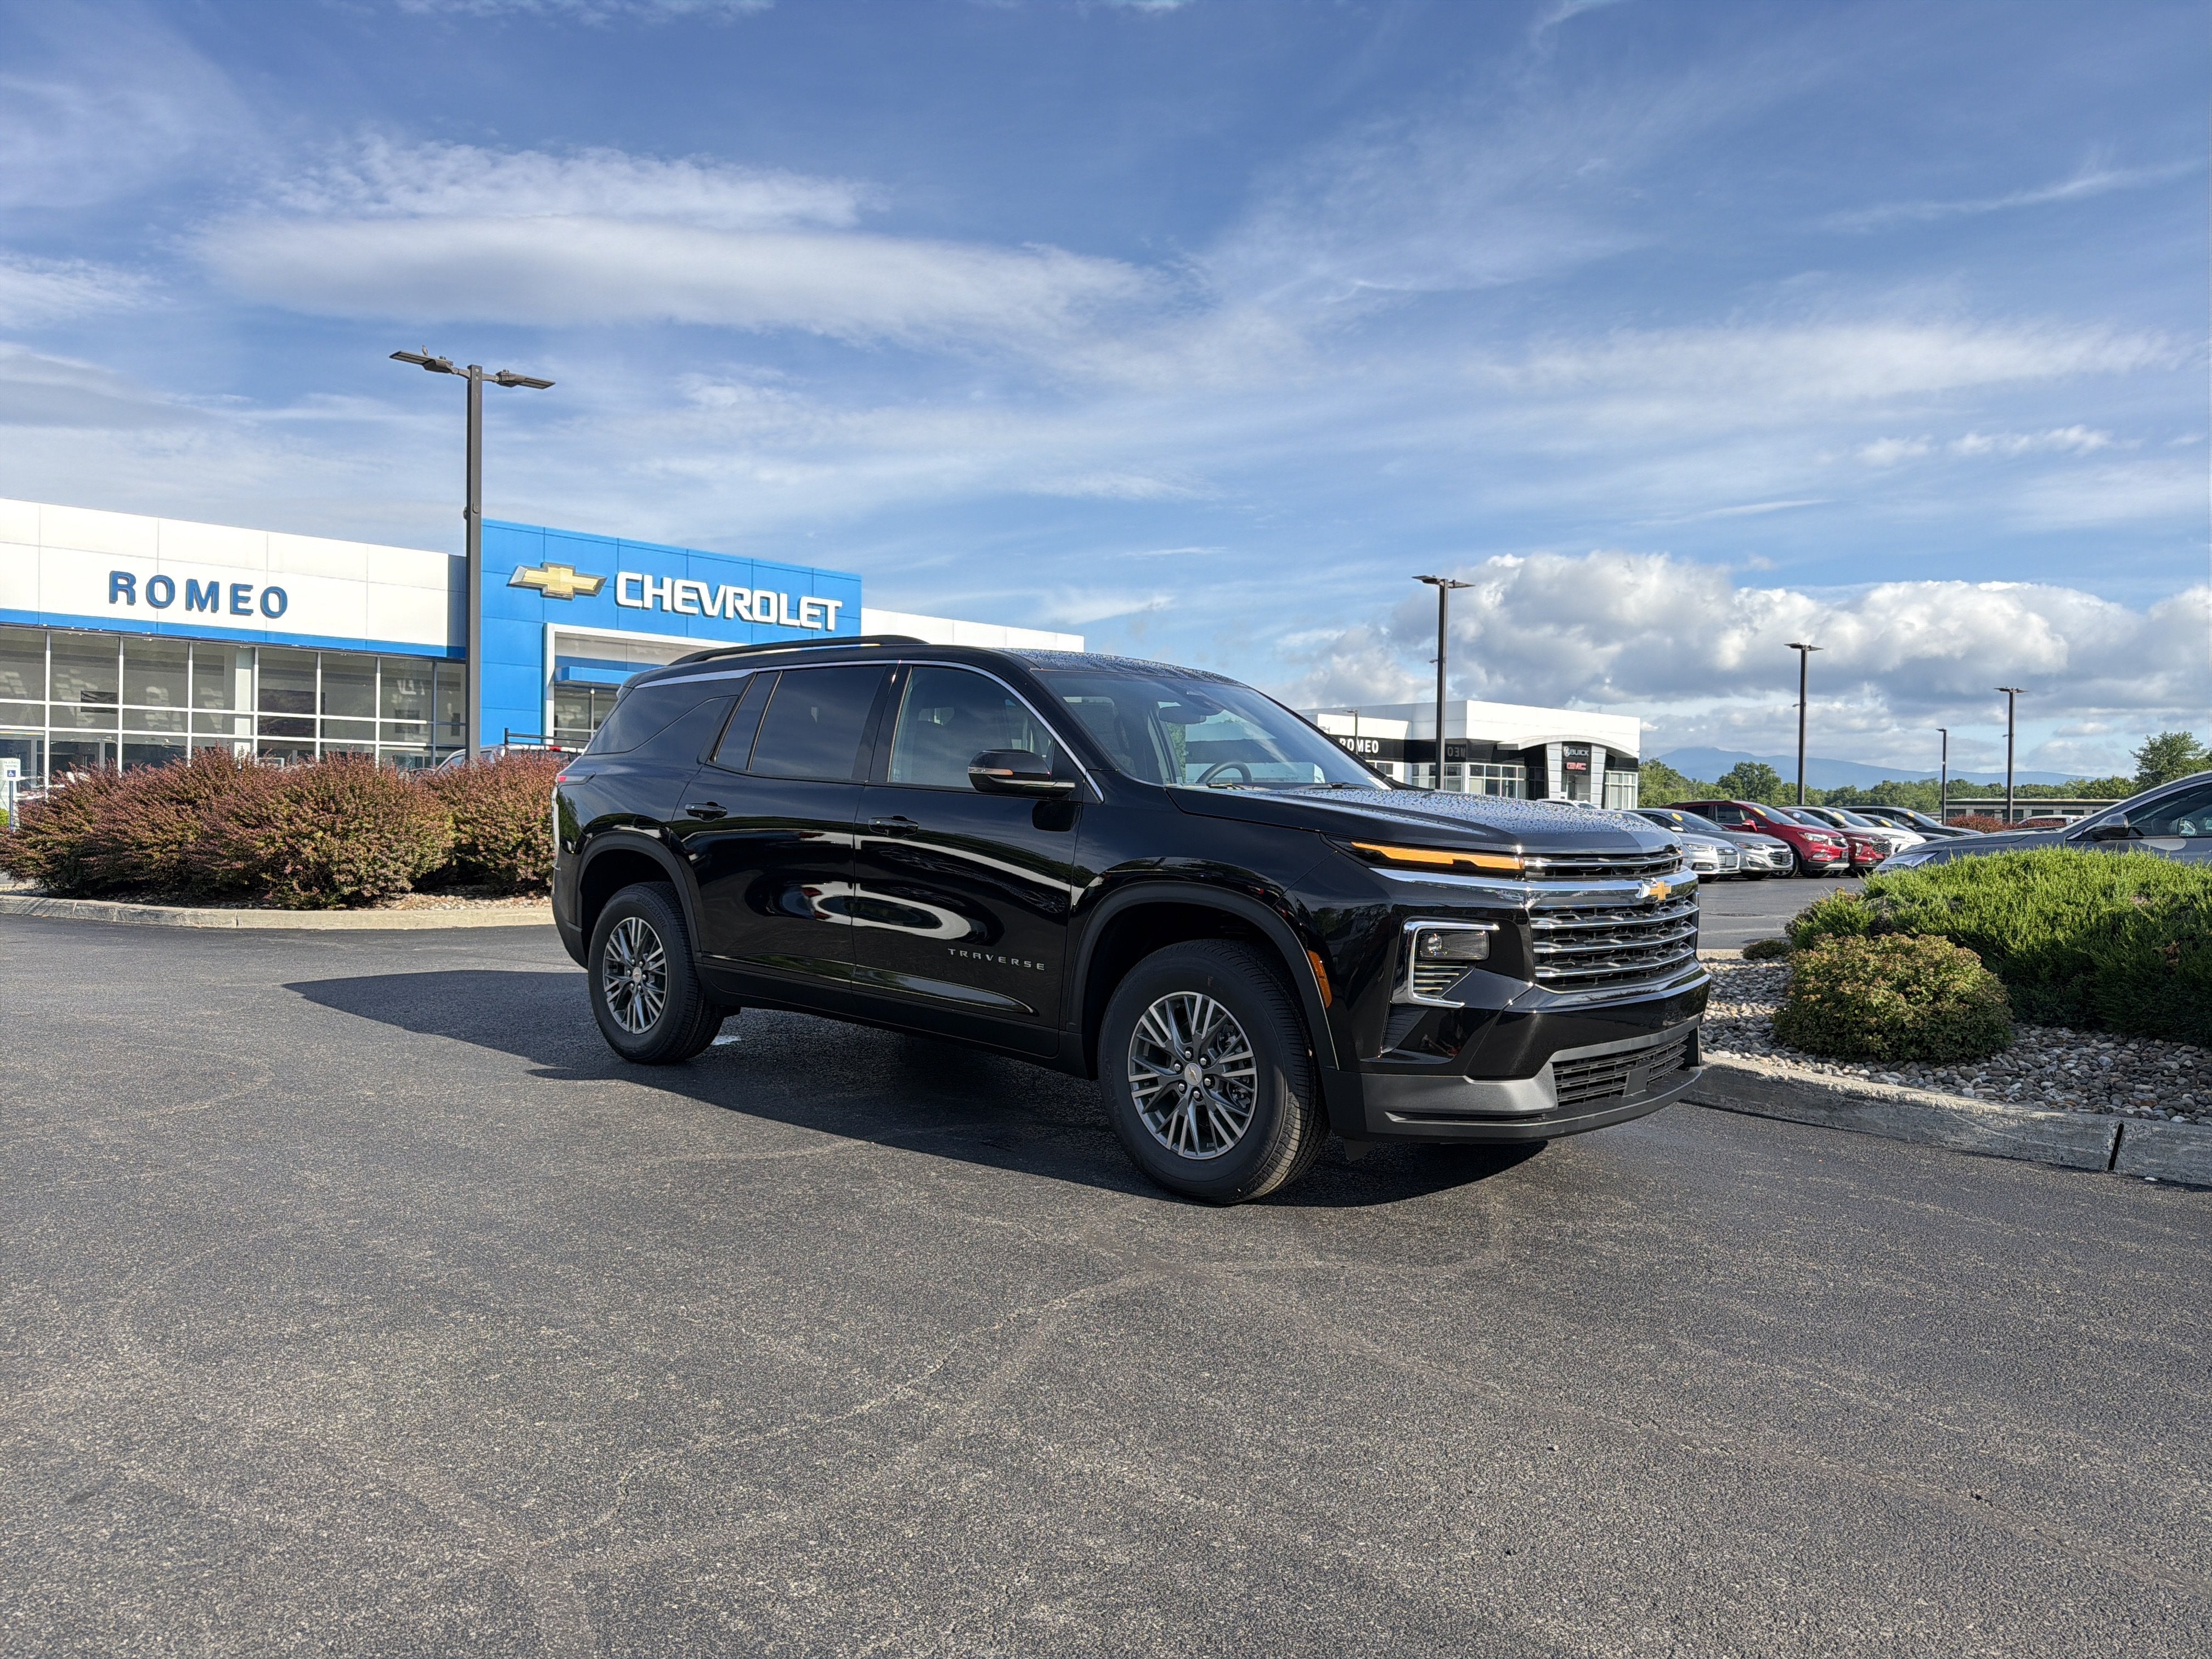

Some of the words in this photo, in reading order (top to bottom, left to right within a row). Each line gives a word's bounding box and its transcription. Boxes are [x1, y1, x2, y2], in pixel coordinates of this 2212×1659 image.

[109, 570, 288, 619] ROMEO
[616, 571, 843, 631] CHEVROLET
[1566, 762, 1587, 770] GMC
[947, 948, 1045, 971] TRAVERSE
